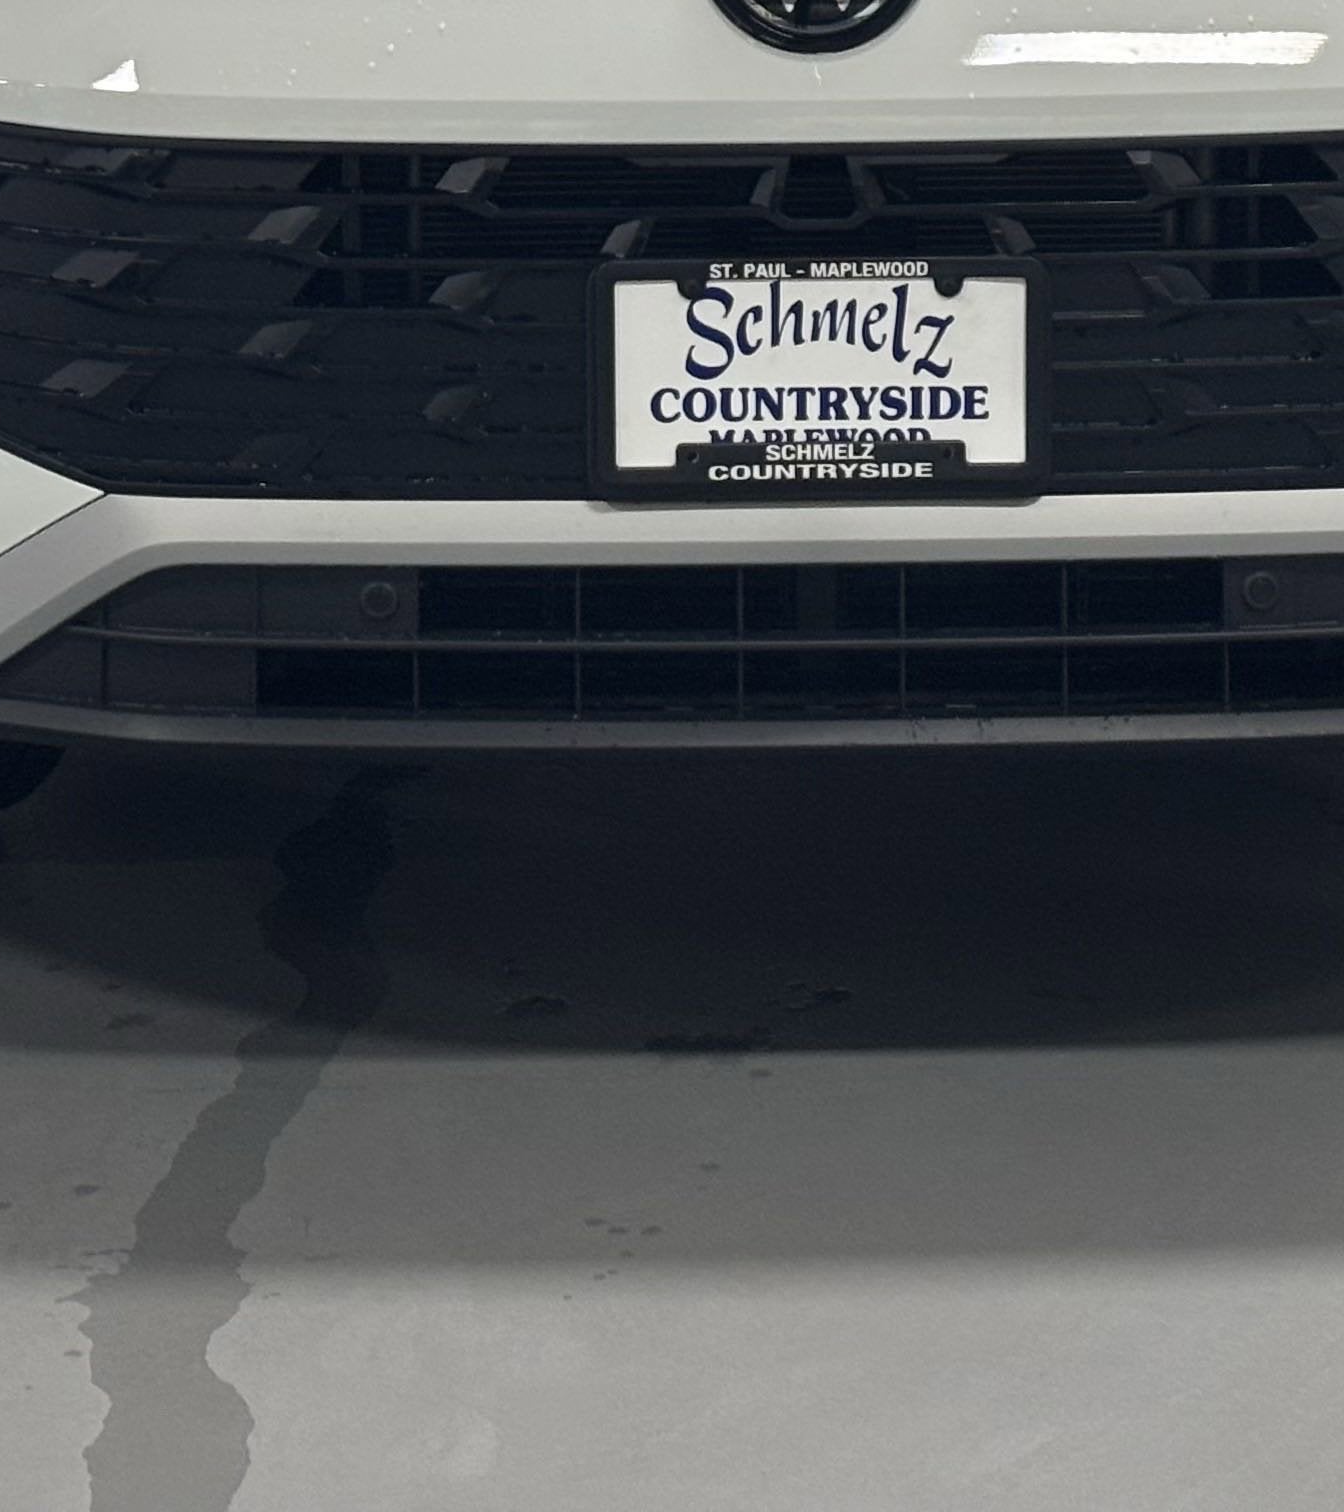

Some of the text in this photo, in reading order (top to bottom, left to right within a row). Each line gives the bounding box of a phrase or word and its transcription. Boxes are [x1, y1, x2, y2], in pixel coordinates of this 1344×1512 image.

[709, 263, 738, 279] ST.
[744, 262, 791, 278] PAUL
[810, 261, 929, 278] MAPLEWOOD
[685, 280, 955, 380] Schmelz
[650, 385, 990, 424] COUNTRYSIDE
[765, 442, 875, 461] SCHMELZ
[708, 462, 934, 481] COUNTRYSIDE
